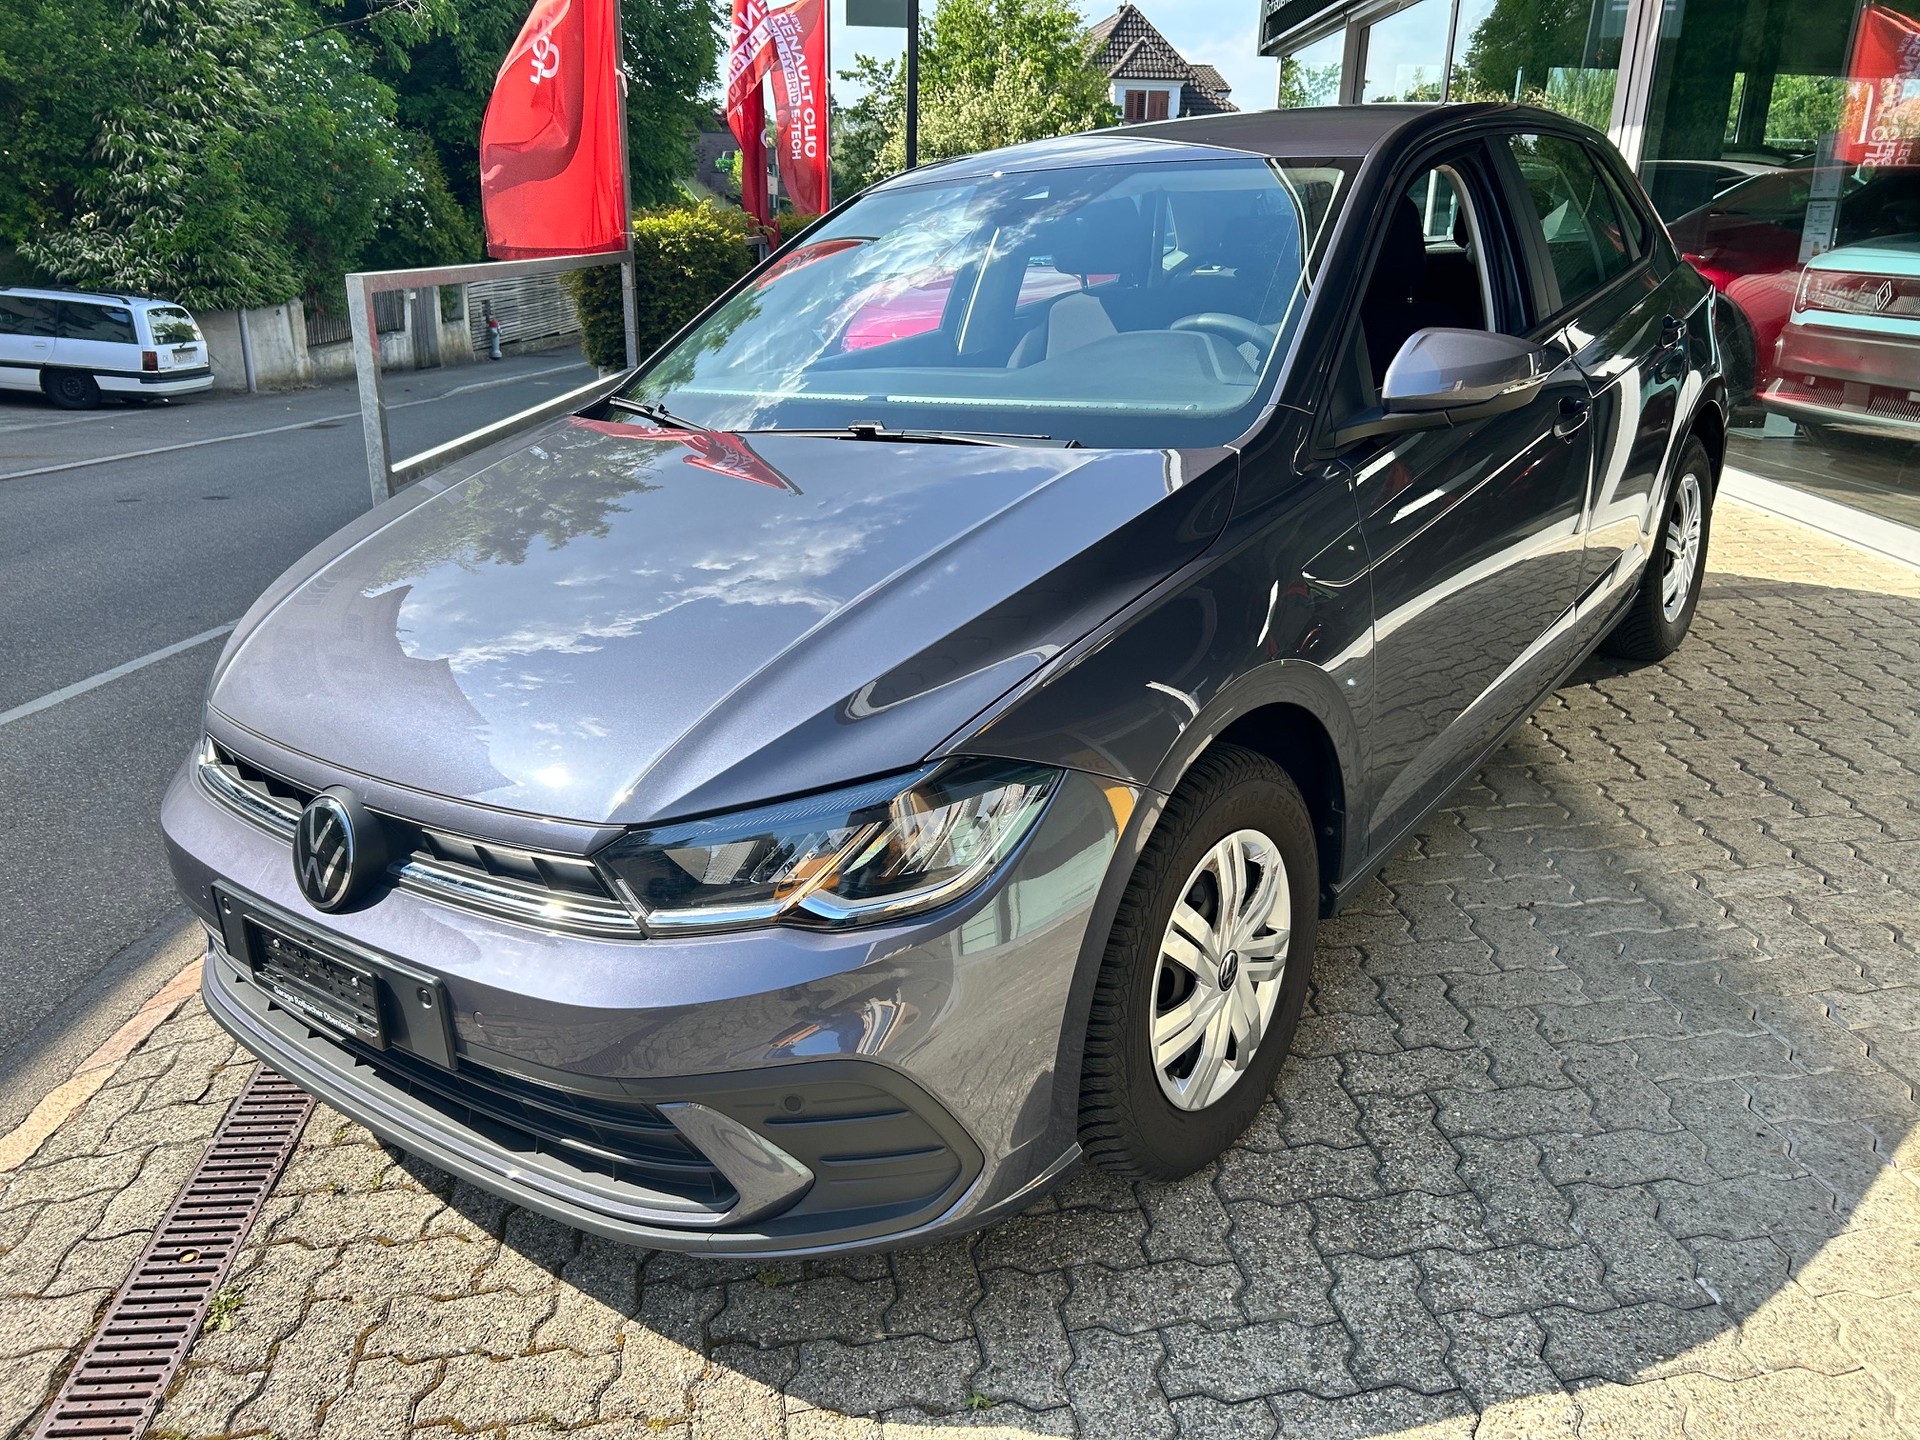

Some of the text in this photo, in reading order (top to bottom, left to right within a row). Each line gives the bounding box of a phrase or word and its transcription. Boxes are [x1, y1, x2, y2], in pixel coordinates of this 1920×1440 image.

[787, 11, 803, 33] NEW
[773, 13, 817, 158] RENAULT CLIO
[780, 51, 799, 105] HYBRID
[790, 109, 802, 160] E-TECH
